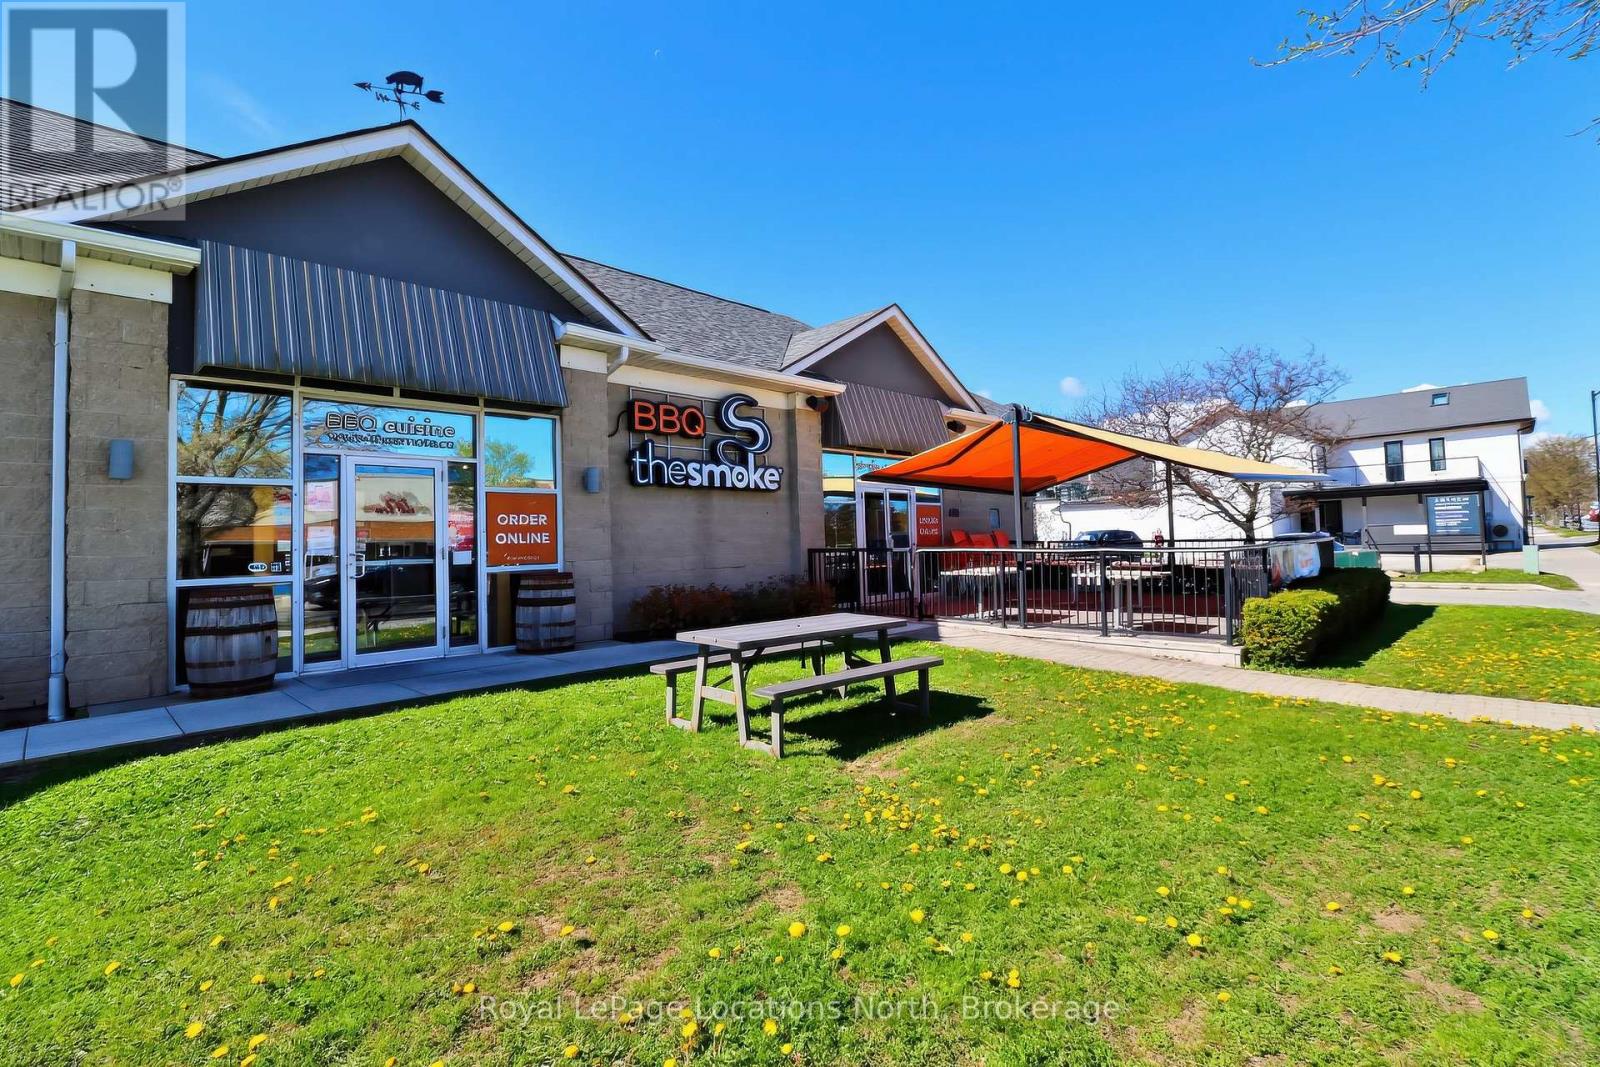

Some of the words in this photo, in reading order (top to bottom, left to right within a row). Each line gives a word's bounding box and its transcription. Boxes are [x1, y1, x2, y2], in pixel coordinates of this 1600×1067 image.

[383, 416, 456, 437] cuisine
[634, 401, 705, 436] BBQ
[497, 513, 548, 526] ORDER
[495, 532, 551, 545] ONLINE
